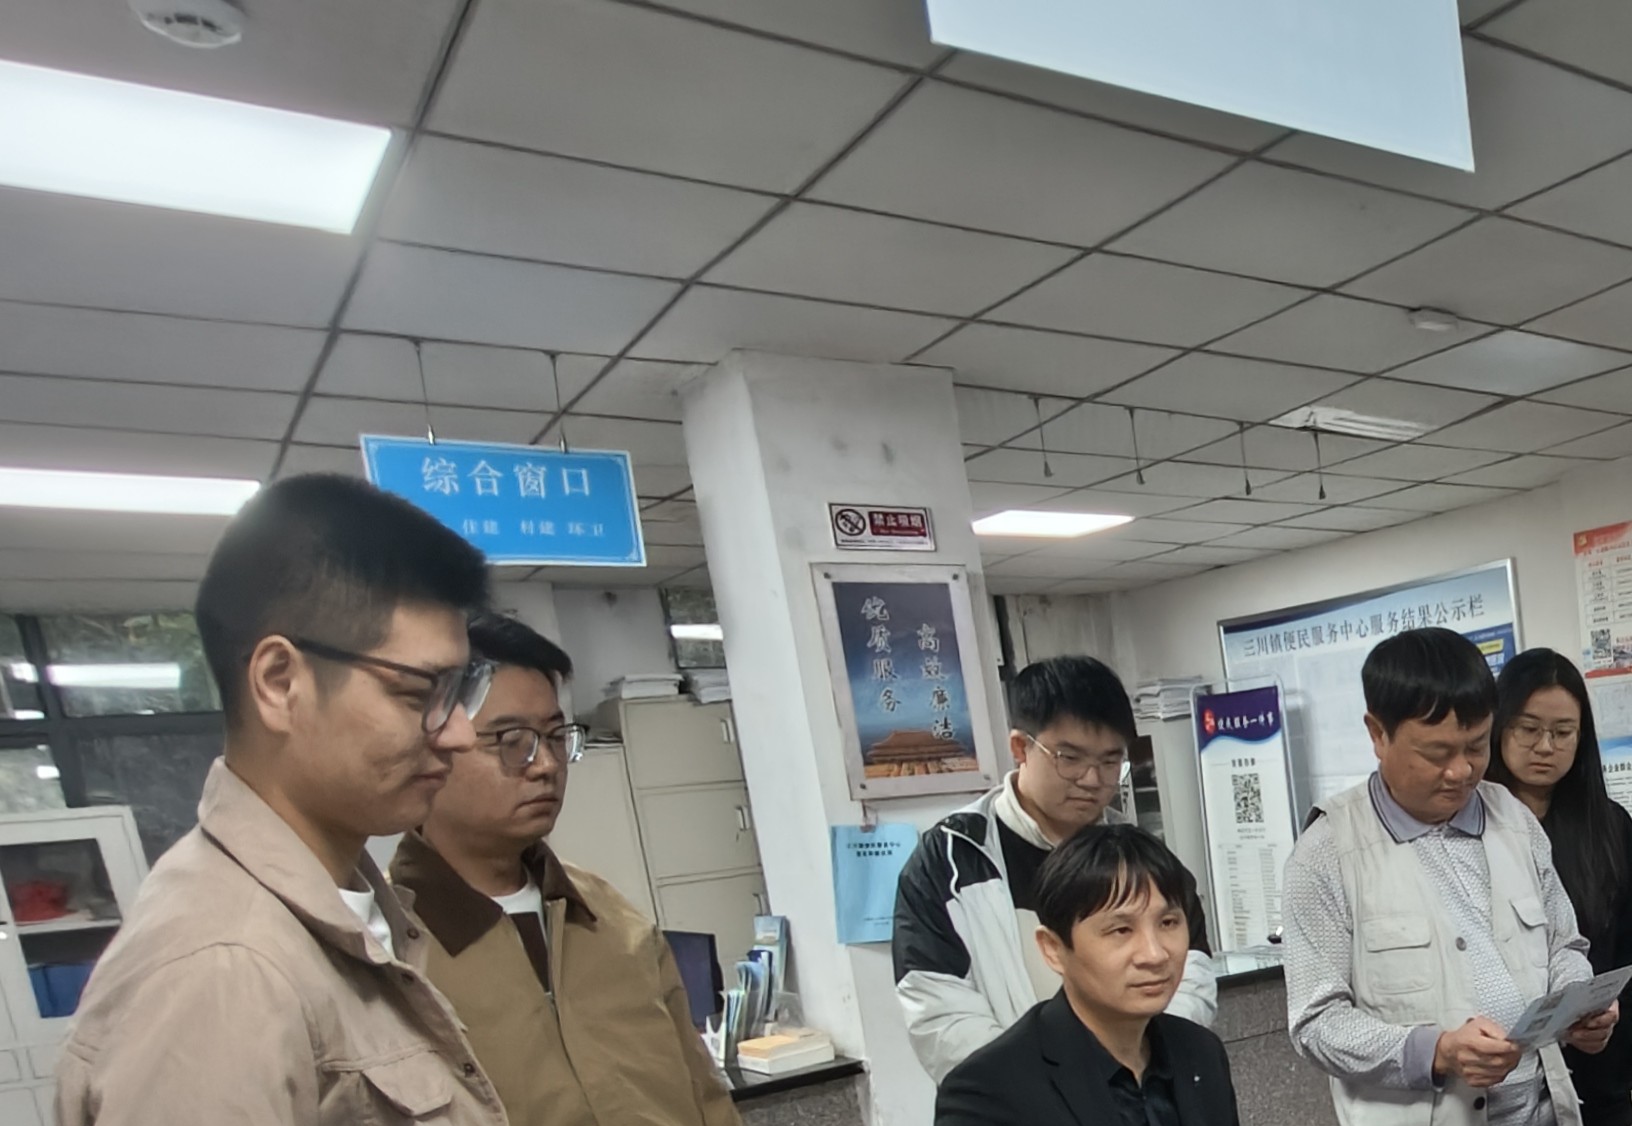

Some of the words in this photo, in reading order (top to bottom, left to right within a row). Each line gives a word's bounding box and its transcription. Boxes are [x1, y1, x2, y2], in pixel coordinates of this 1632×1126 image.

[421, 456, 591, 499] 综合窗口
[861, 596, 902, 713] 优质服务
[1243, 593, 1486, 657] 三川镇便民服务中心服务结果公示栏
[916, 623, 955, 740] 高效廉洁
